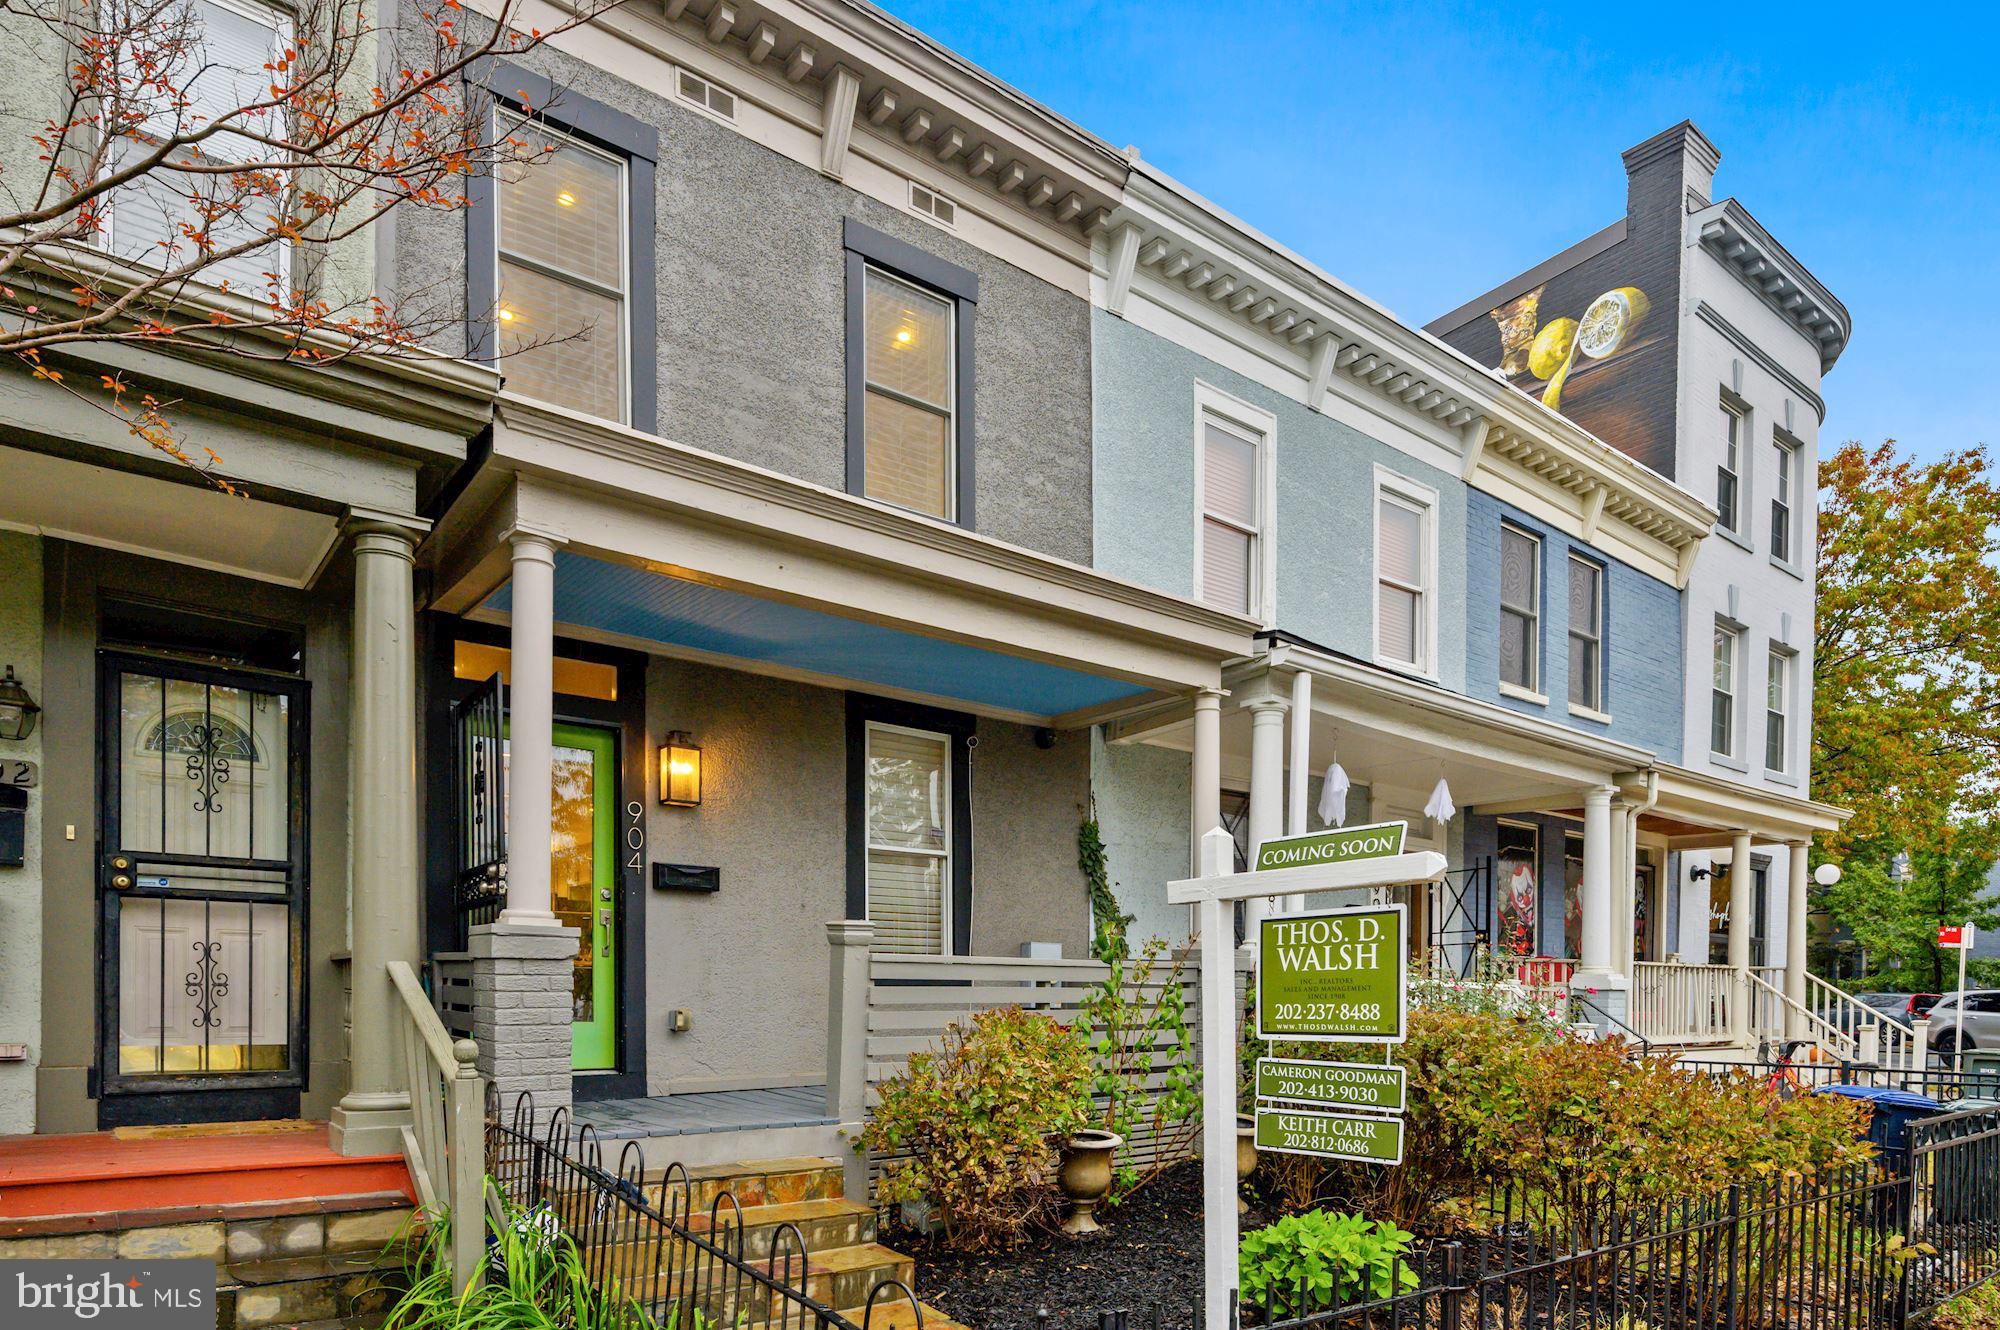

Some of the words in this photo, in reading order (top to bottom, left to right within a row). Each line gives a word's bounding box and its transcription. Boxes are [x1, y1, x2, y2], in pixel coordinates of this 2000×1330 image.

[0, 763, 30, 783] 2
[627, 801, 643, 874] 904
[1262, 843, 1336, 865] COMING
[1339, 836, 1395, 856] SOON
[1272, 920, 1349, 946] THOS.
[1358, 918, 1385, 942] D.
[1276, 943, 1380, 972] WALSH
[1262, 1065, 1321, 1080] CAMERON
[1325, 1069, 1397, 1085] GOODMAN
[1278, 1116, 1327, 1134] KEITH
[1332, 1120, 1377, 1138] CARR
